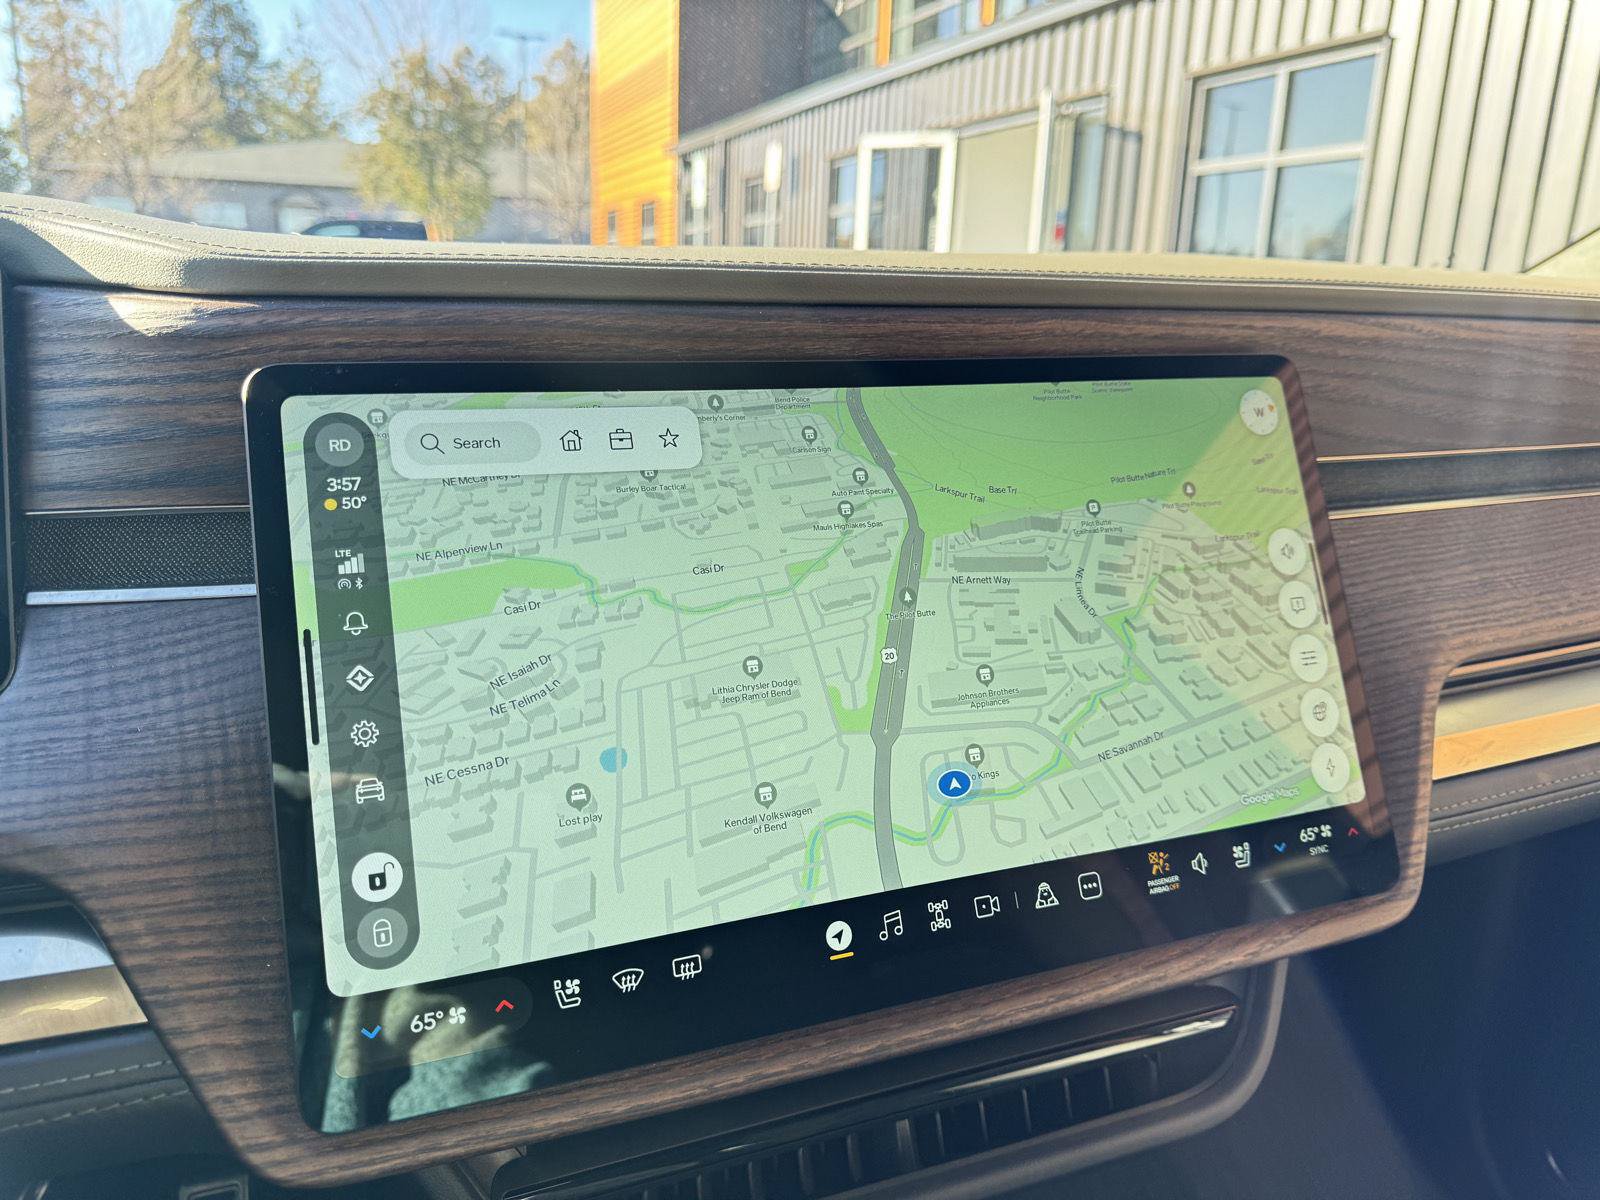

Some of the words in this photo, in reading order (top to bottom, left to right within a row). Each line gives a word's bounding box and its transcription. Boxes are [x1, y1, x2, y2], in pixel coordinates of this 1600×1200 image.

[1254, 408, 1264, 417] W
[328, 439, 351, 453] RD
[453, 437, 501, 450] Search
[792, 446, 818, 454] Carlson
[817, 445, 832, 454] Sign
[326, 477, 362, 492] 3:57
[442, 478, 457, 486] NE
[866, 488, 894, 496] Specialty
[935, 483, 968, 499] Larkspur
[969, 492, 986, 504] Trail
[988, 485, 1006, 494] Base
[866, 520, 884, 529] Spas
[335, 549, 352, 558] LTE
[416, 552, 433, 562] NE
[434, 544, 489, 561] Alpenview
[489, 541, 503, 551] Ln
[692, 564, 713, 575] Casi
[713, 563, 725, 573] Dr
[952, 575, 964, 585] NE
[966, 575, 992, 585] Arnett
[994, 575, 1011, 586] Way
[1075, 566, 1085, 581] NE
[1087, 607, 1098, 619] Dr
[503, 604, 527, 616] Casi
[528, 600, 541, 611] Dr
[886, 612, 899, 620] The
[916, 609, 936, 618] Butte
[884, 652, 895, 660] 20
[489, 674, 508, 691] NE
[507, 660, 539, 683] Isaiah
[538, 653, 552, 667] Dr
[711, 685, 735, 696] Lithia
[735, 682, 770, 694] Chrysler
[770, 678, 799, 689] Dodge
[957, 691, 988, 702] Johnson
[988, 686, 1020, 697] Brothers
[489, 702, 508, 717] NE
[508, 690, 547, 711] Telima
[544, 678, 561, 692] Ln
[721, 694, 741, 705] Jeep
[741, 691, 760, 701] Ram
[761, 690, 770, 700] of
[770, 688, 792, 698] Bend
[970, 697, 1010, 709] Appliances
[1097, 752, 1114, 762] NE
[1112, 736, 1155, 758] Savannah
[1152, 730, 1164, 742] Dr
[424, 772, 445, 787] NE
[446, 761, 494, 781] Cessna
[494, 755, 510, 769] Dr
[976, 769, 1000, 781] Kings
[1240, 790, 1275, 806] Google
[1275, 785, 1300, 799] Maps
[558, 814, 582, 828] Lost
[582, 811, 603, 825] play
[724, 815, 759, 828] Kendall
[758, 806, 813, 824] Volkswagen
[753, 825, 763, 835] of
[763, 821, 788, 834] Bend
[1308, 844, 1330, 856] SYNC
[1147, 874, 1180, 888] PASSENGER
[1149, 885, 1171, 895] AIRBAG
